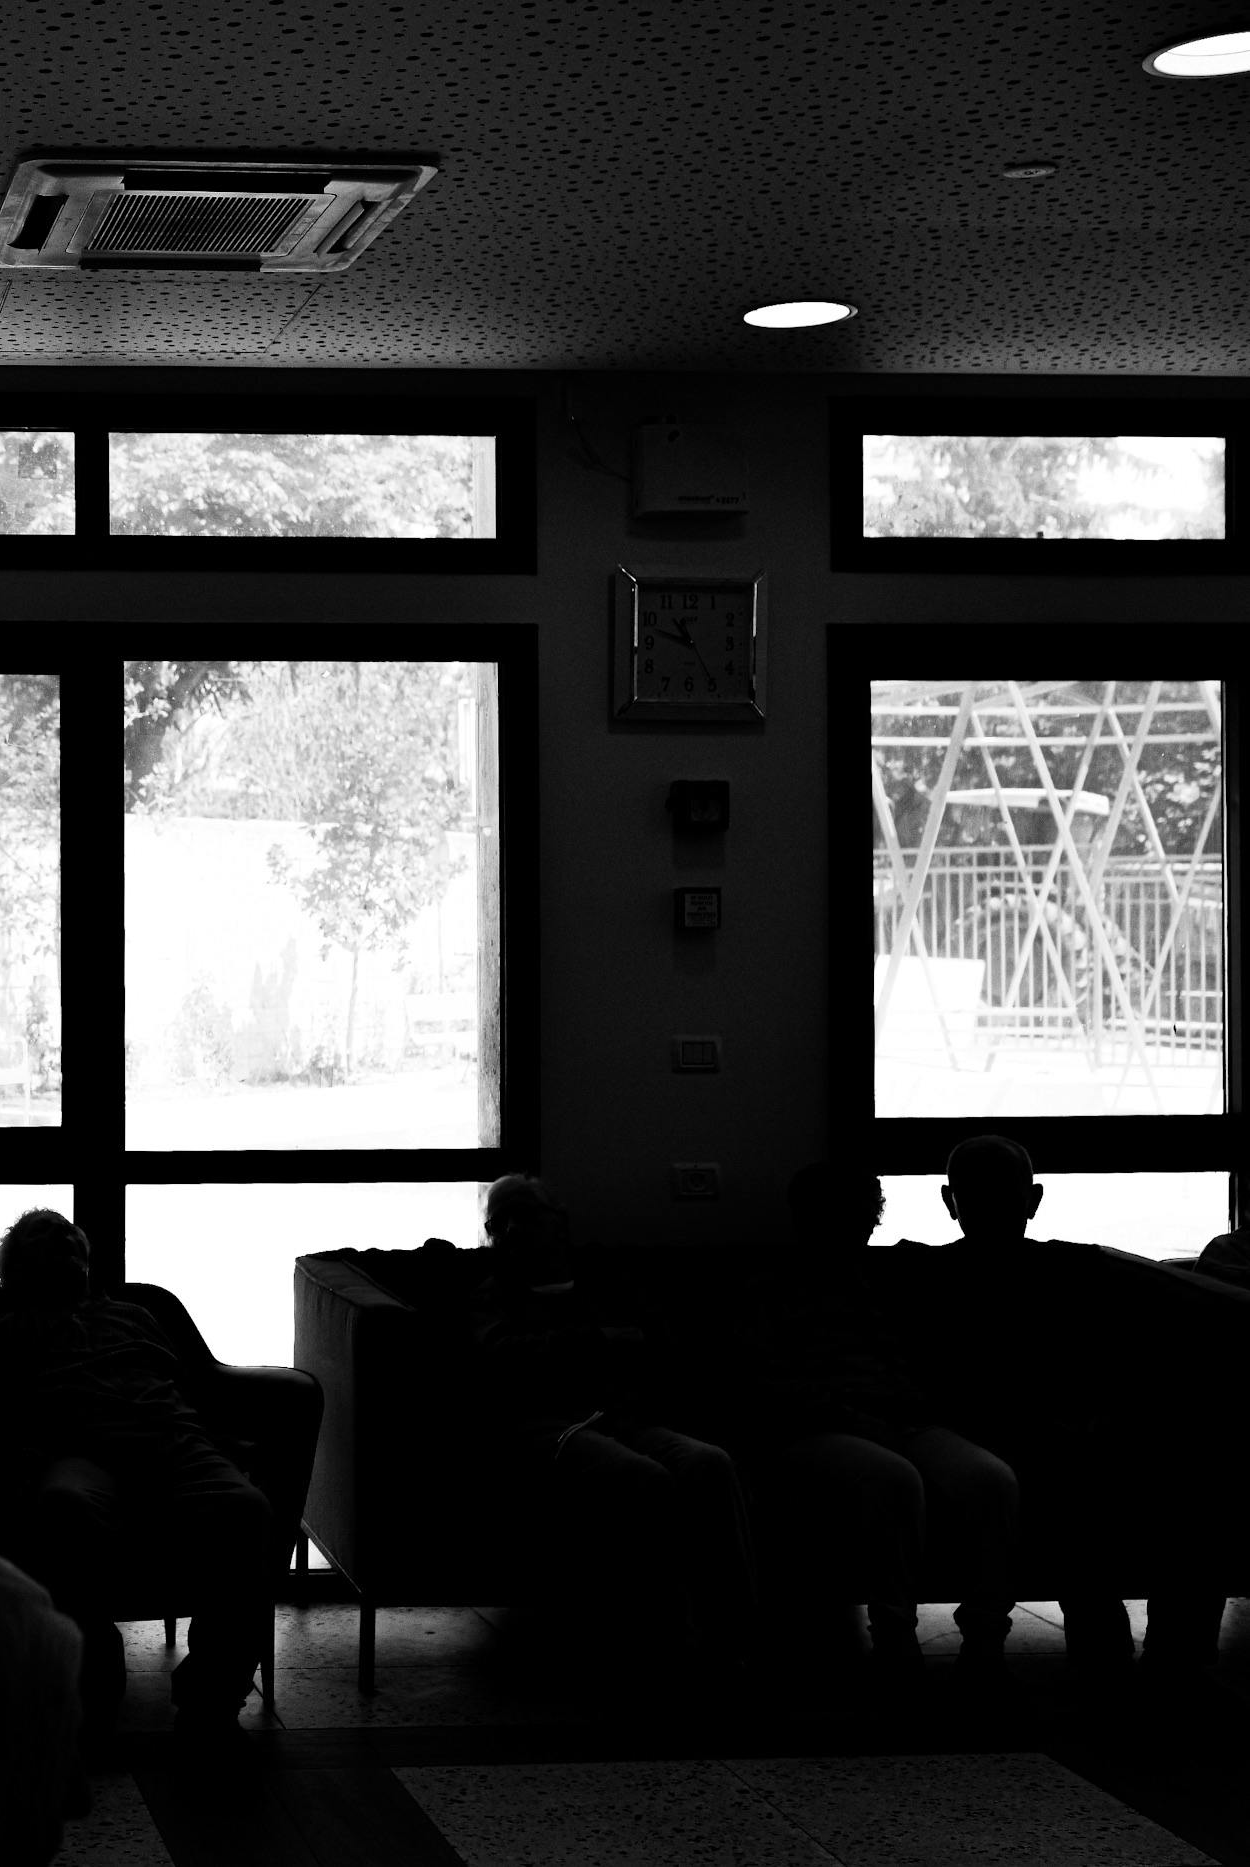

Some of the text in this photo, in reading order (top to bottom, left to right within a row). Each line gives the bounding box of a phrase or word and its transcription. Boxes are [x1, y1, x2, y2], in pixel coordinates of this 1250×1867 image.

[660, 595, 672, 609] 11
[682, 594, 698, 609] 12
[710, 595, 716, 609] 1
[643, 612, 657, 626] 10
[726, 613, 734, 627] 2
[645, 636, 654, 650] 9
[726, 636, 733, 651] 3
[644, 659, 654, 673] 8
[725, 660, 733, 675] 4
[662, 677, 670, 691] 7
[684, 676, 694, 692] 6
[708, 678, 716, 692] 5
